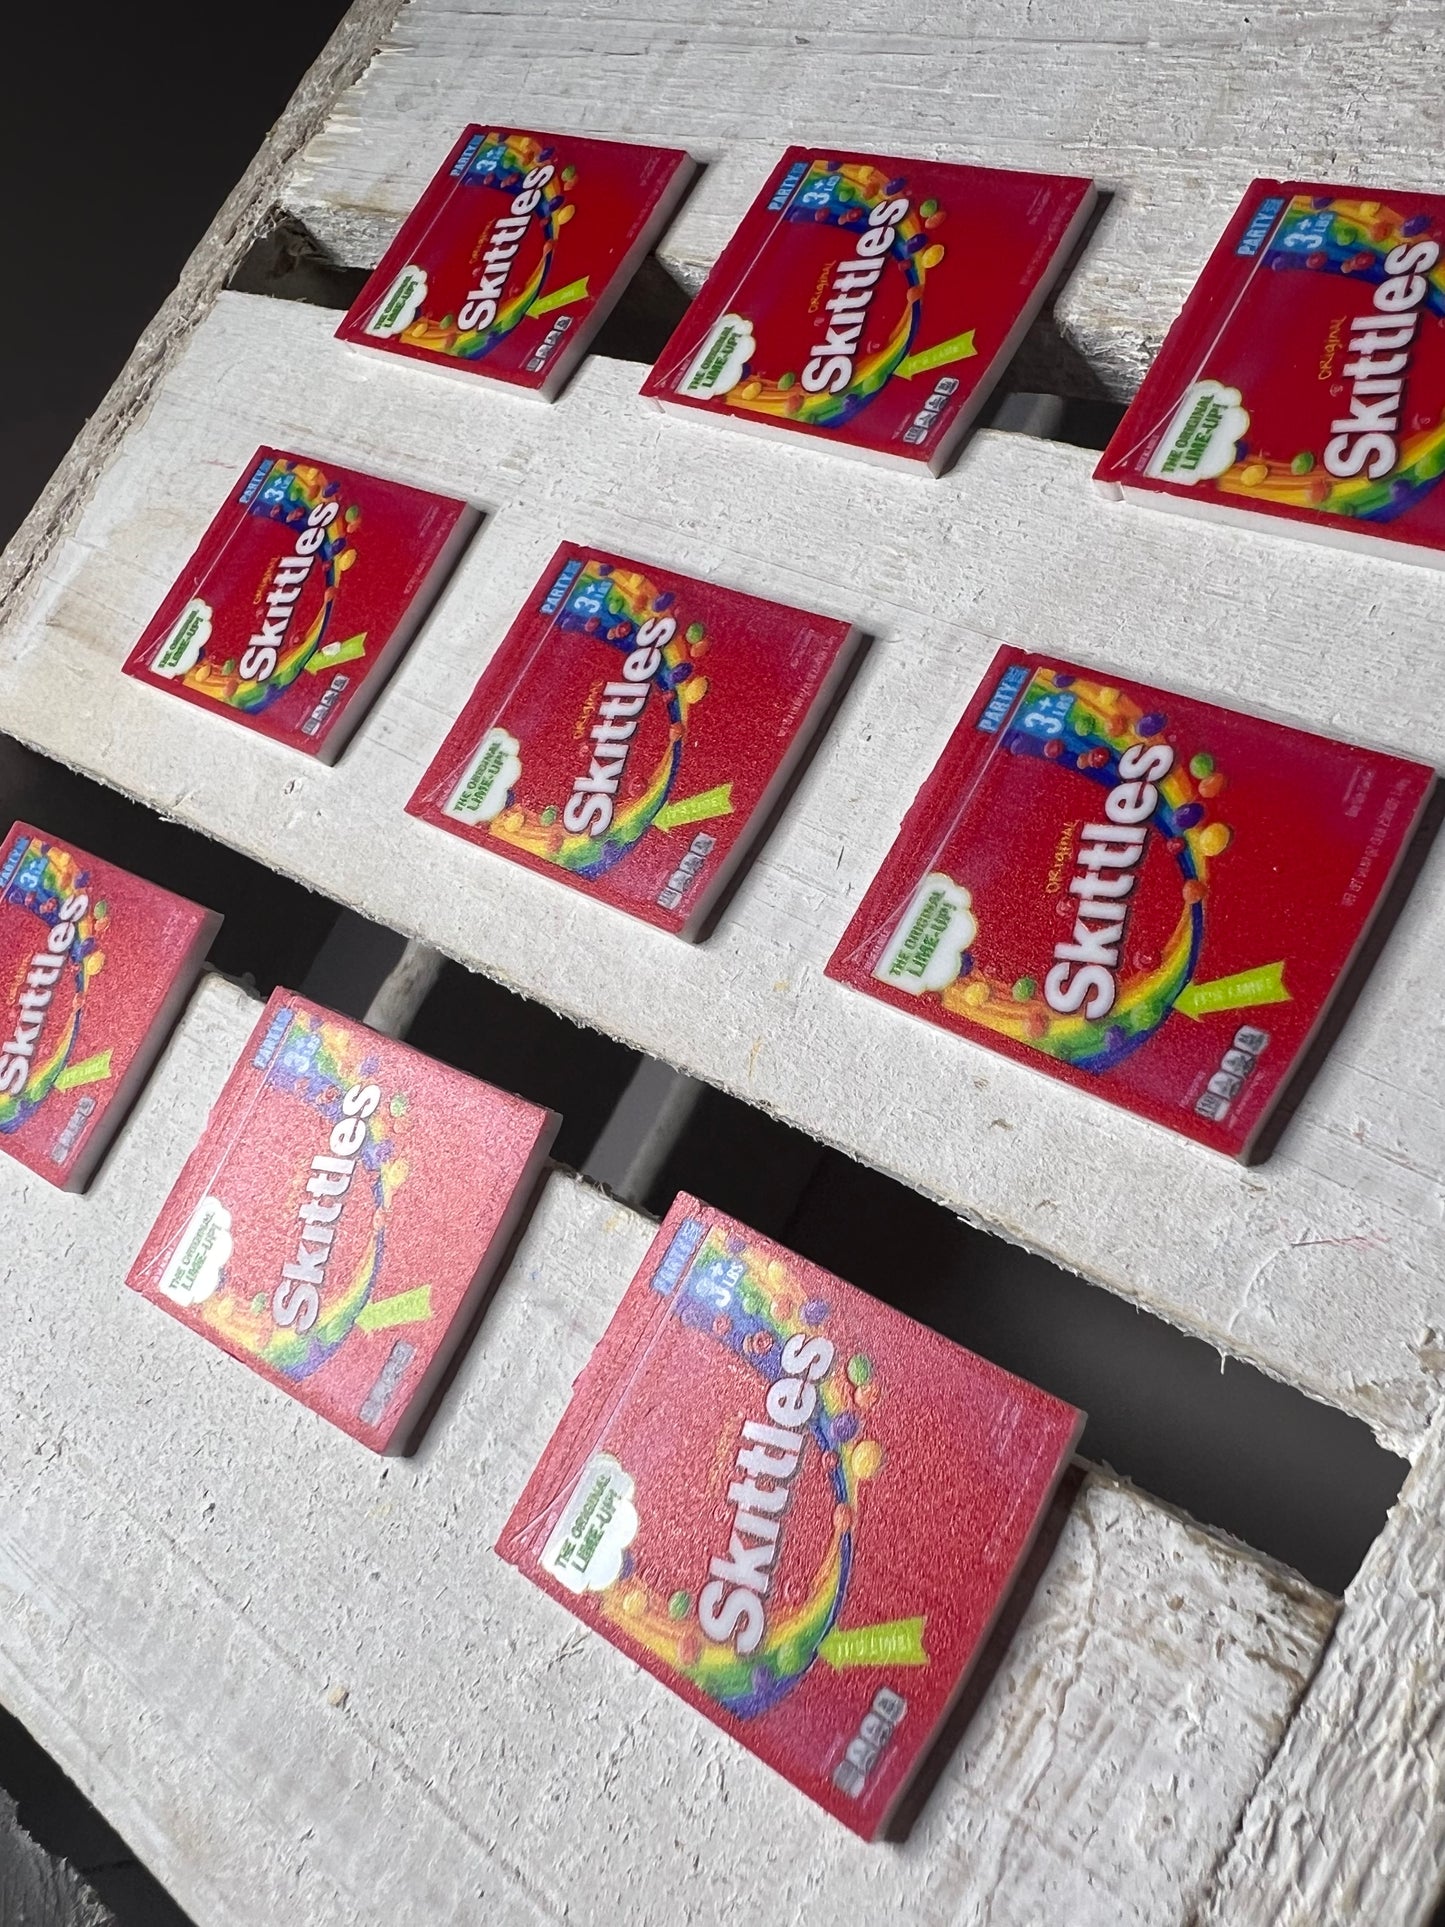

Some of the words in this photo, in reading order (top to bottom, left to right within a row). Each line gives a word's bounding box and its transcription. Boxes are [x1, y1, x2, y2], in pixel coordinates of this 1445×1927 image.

[766, 174, 800, 210] PARTY
[457, 165, 554, 330] Skittles
[1236, 212, 1273, 254] PARTY
[801, 199, 910, 394] Skittles
[687, 371, 705, 390] THE
[700, 332, 743, 388] LIME-UP!
[1324, 241, 1439, 479] Skittles
[1160, 449, 1182, 471] THE
[1174, 394, 1214, 447] ORIGINAL
[1180, 402, 1228, 470] LIME-UP!
[239, 501, 339, 682] Skittles
[539, 573, 574, 615] PARTY
[563, 616, 677, 836] Skittles
[977, 680, 1020, 732] PARTY
[466, 741, 501, 790] ORIGINAL
[1044, 742, 1175, 1020] Skittles
[889, 951, 911, 977] THE
[903, 888, 945, 950] ORIGINAL
[0, 893, 88, 1097] Skittles
[272, 1082, 380, 1332] Skittles
[722, 1260, 745, 1288] LBS
[568, 1471, 611, 1541] ORIGINAL
[699, 1333, 835, 1655] Skittles
